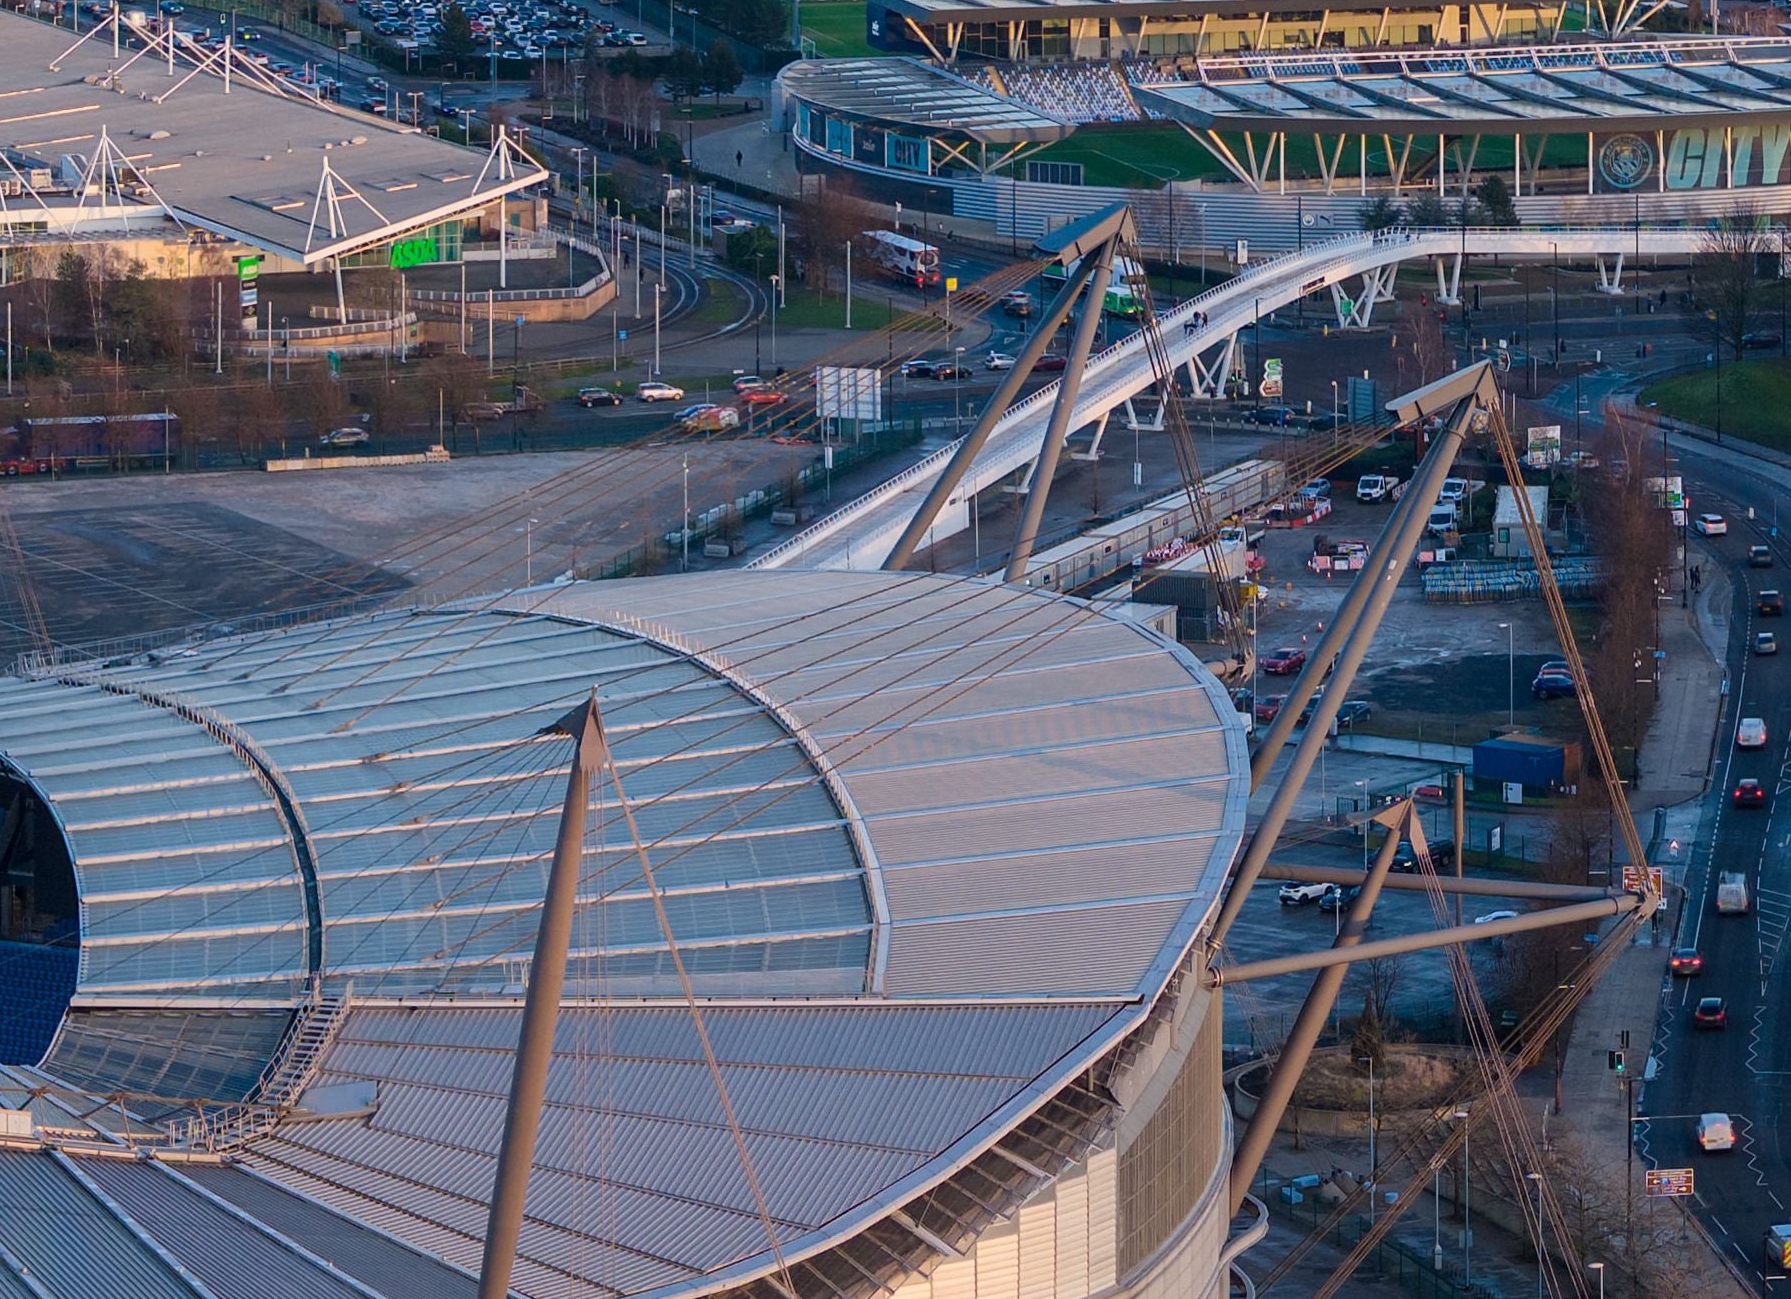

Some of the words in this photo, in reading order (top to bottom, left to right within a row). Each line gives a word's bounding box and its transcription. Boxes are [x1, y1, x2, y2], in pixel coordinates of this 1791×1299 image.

[894, 138, 921, 167] CITY
[1666, 124, 1791, 188] CITY
[390, 239, 438, 268] ASDA
